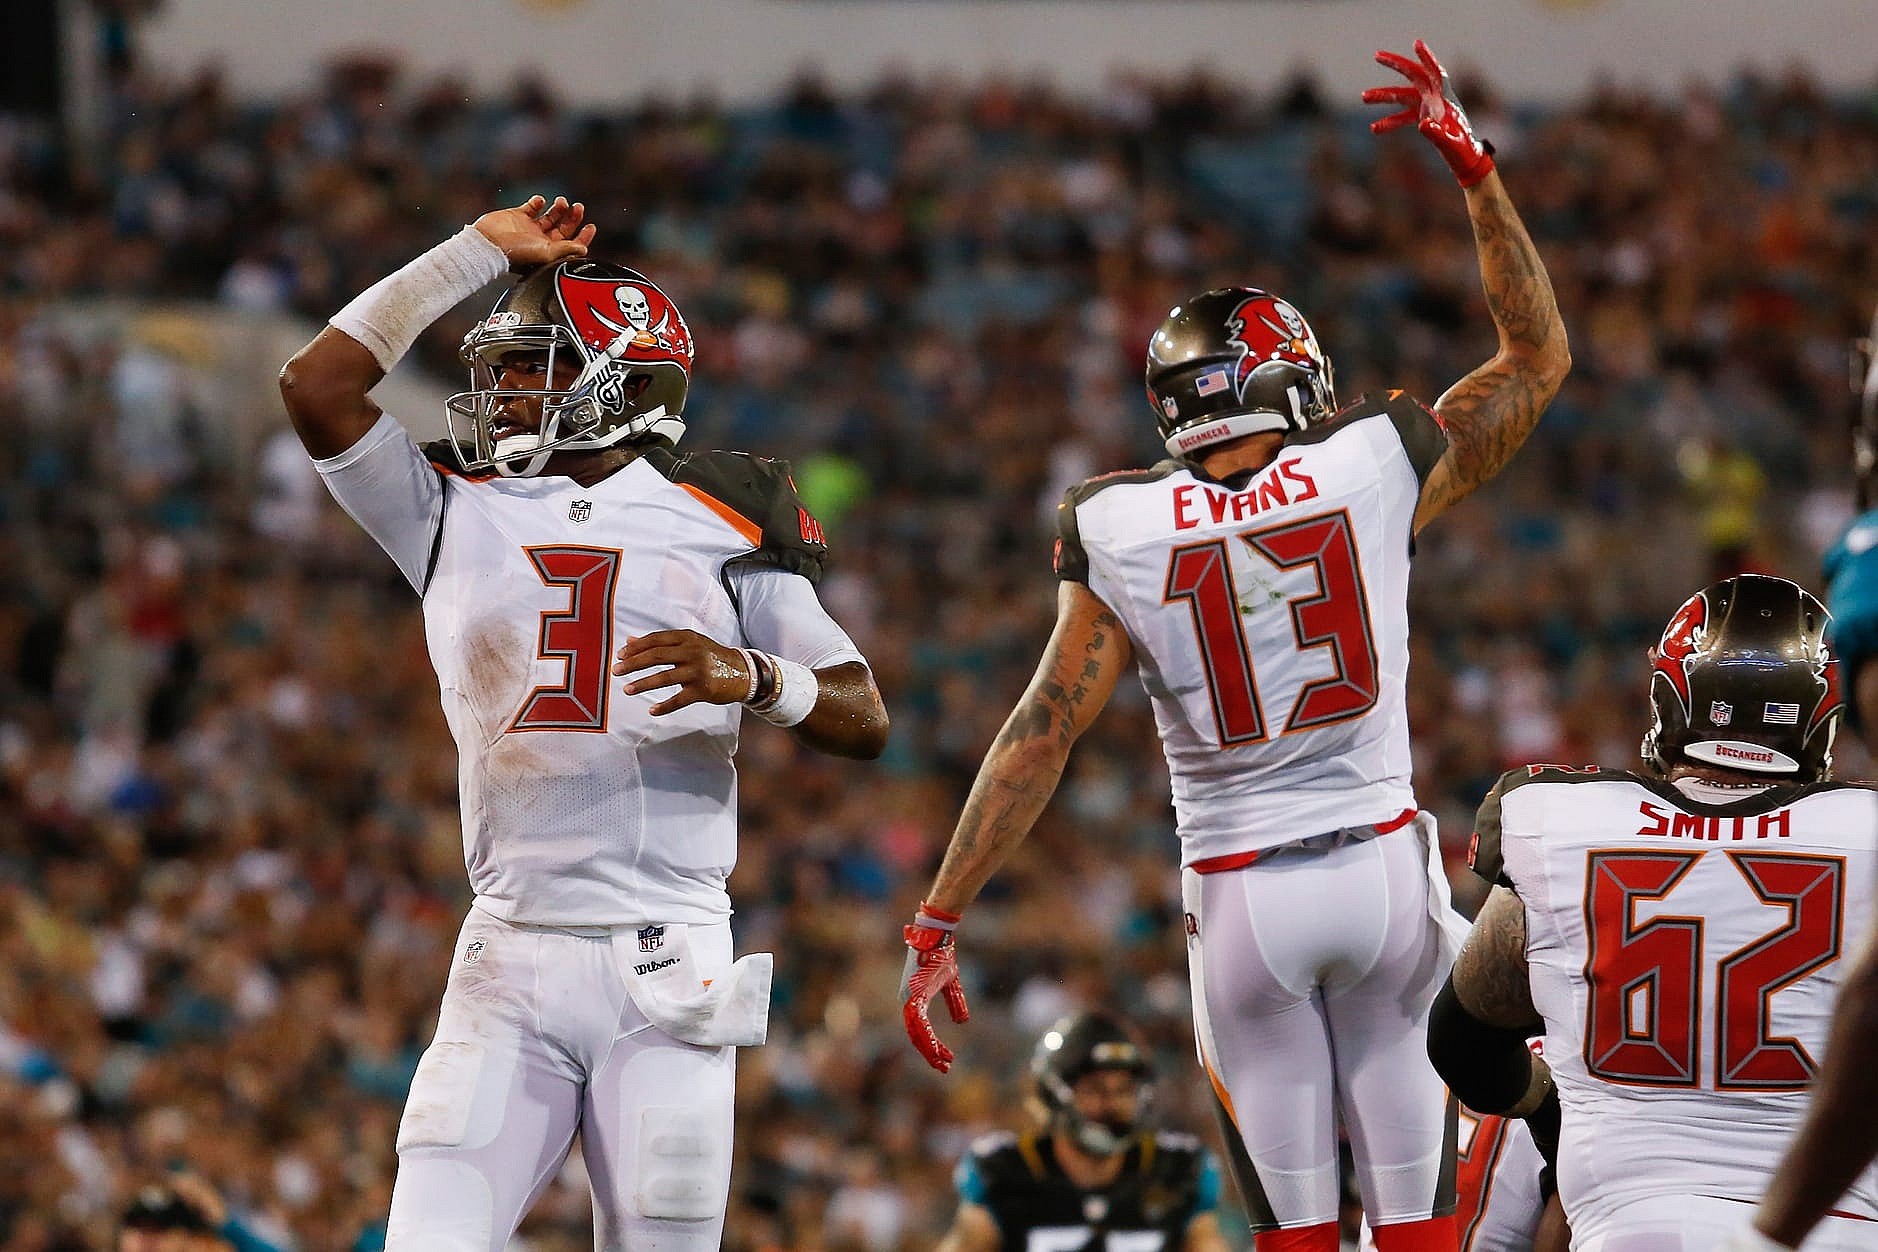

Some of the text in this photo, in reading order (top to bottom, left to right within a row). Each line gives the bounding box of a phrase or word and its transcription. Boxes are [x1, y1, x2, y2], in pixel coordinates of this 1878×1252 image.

[571, 508, 590, 520] NFL
[1172, 457, 1318, 530] EVANS
[506, 544, 624, 733] 3
[1162, 506, 1380, 750] 13
[1715, 744, 1774, 763] BUCCANEERS
[1636, 800, 1792, 841] SMITH
[640, 936, 664, 950] NFL
[1582, 848, 1847, 1092] 62
